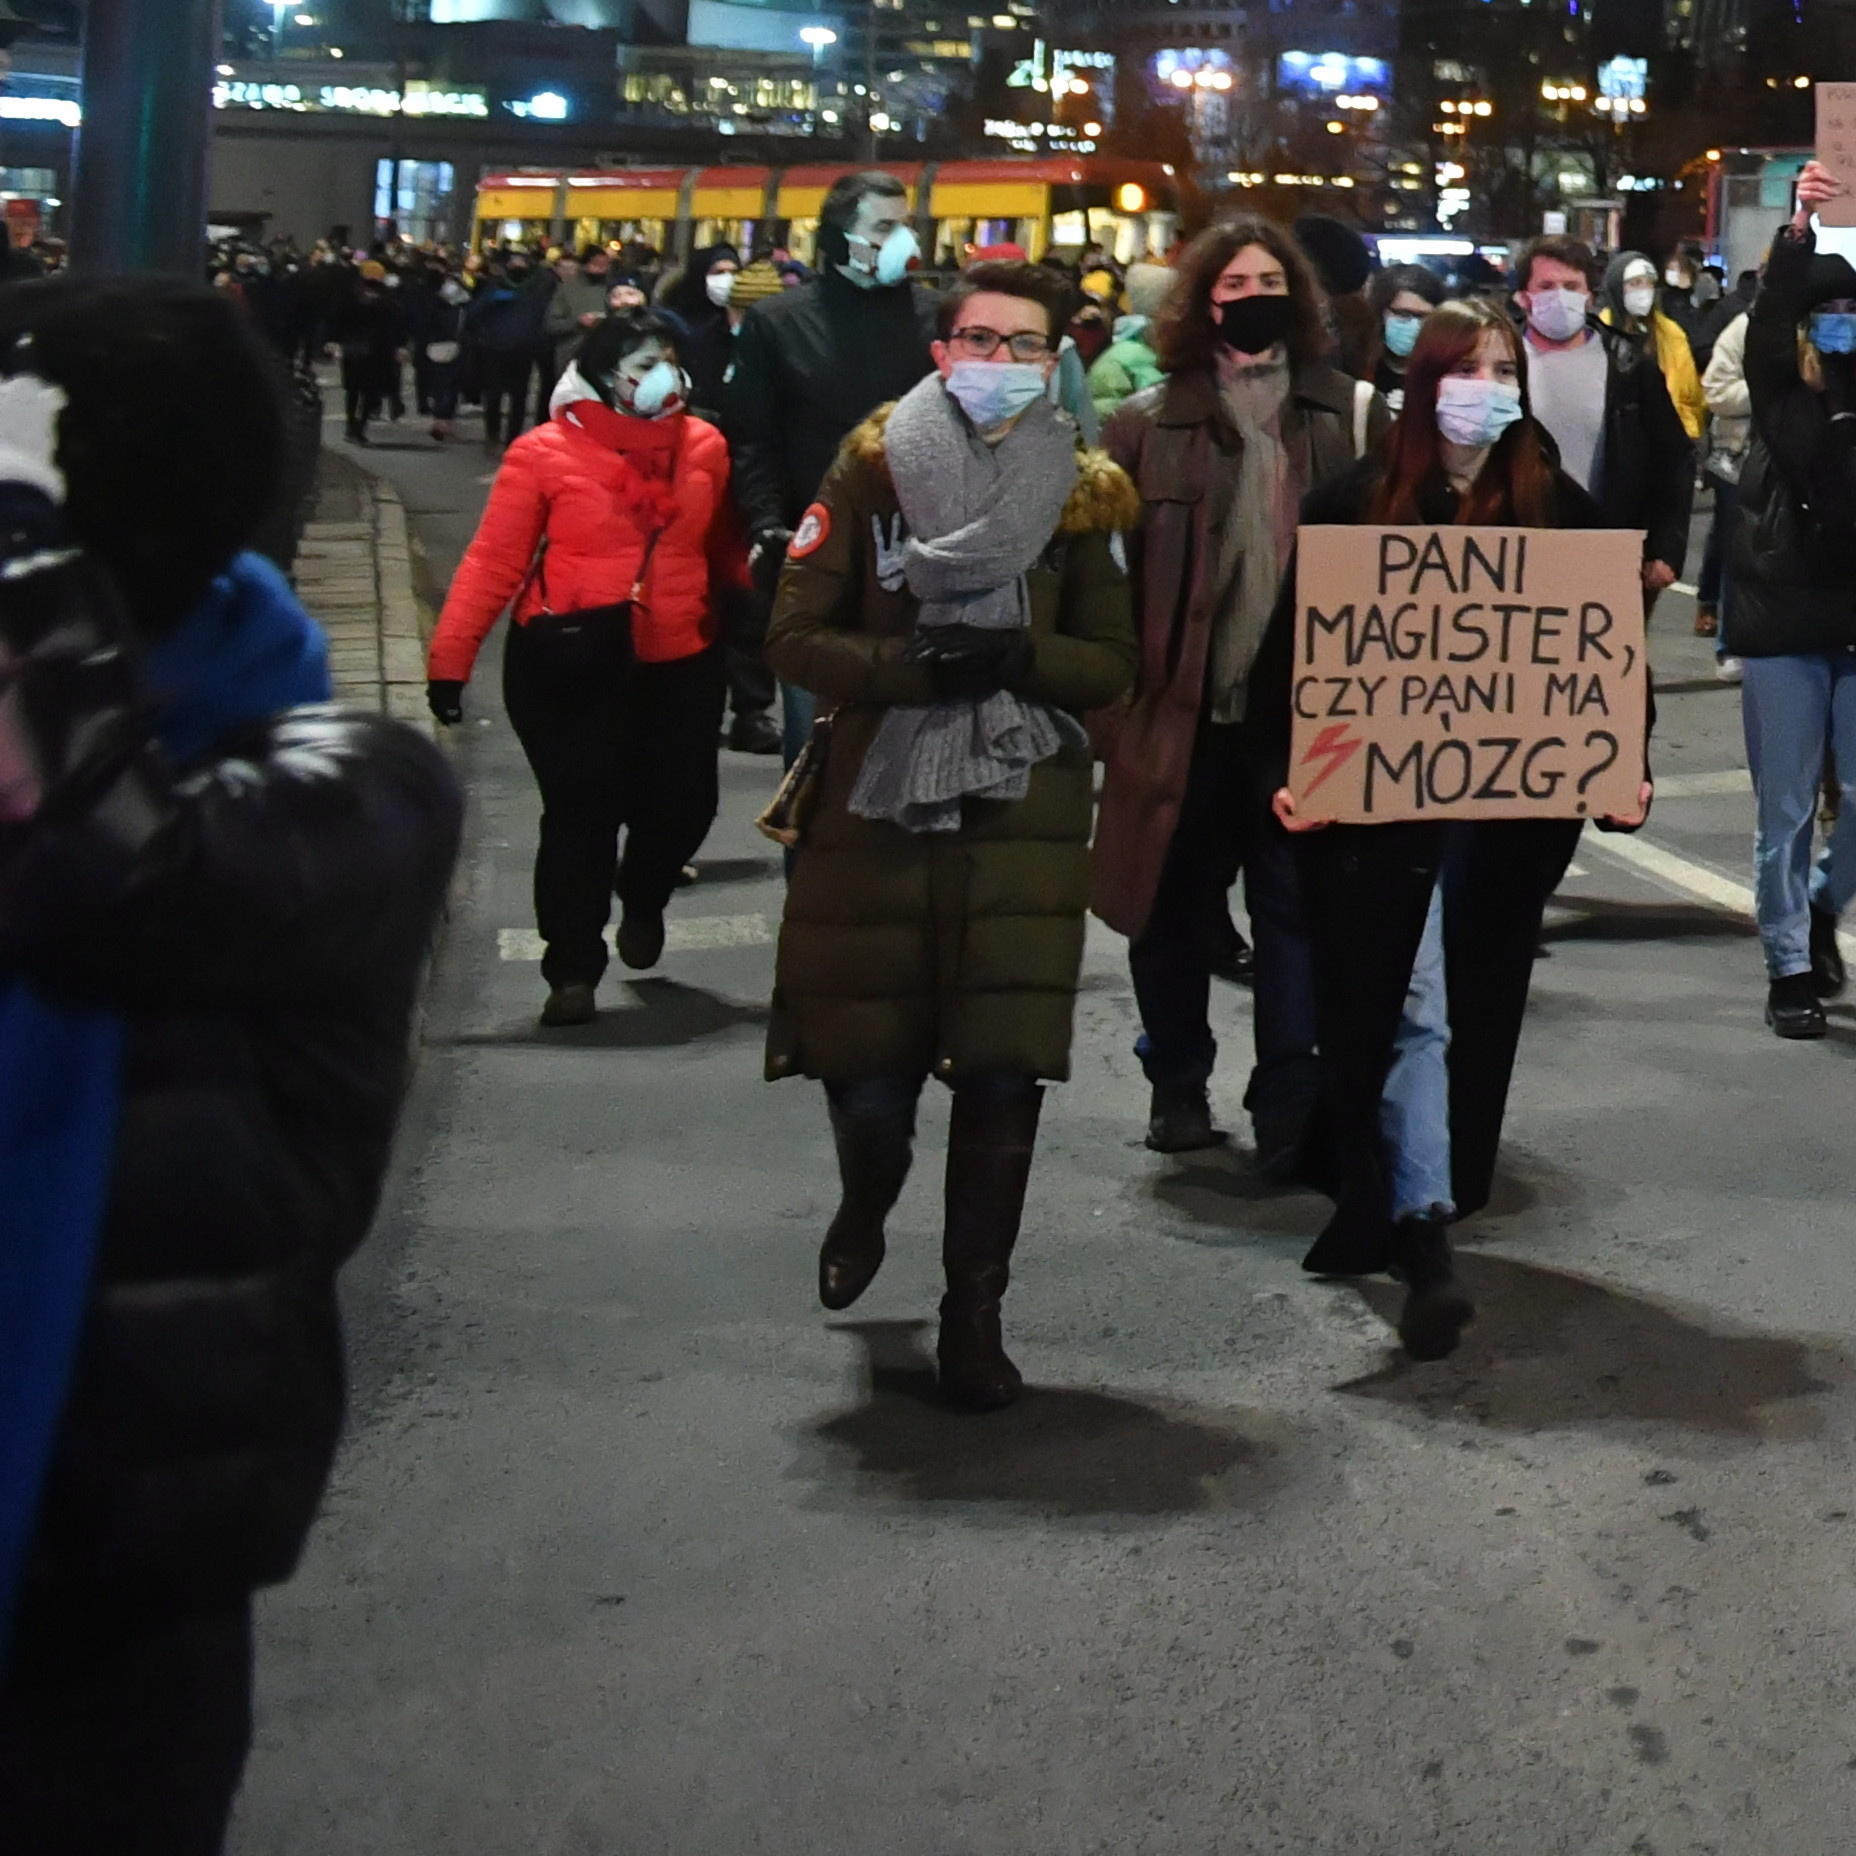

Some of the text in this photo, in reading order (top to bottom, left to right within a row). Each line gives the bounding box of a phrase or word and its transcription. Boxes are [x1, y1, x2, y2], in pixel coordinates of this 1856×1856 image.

[1377, 531, 1527, 595] PANI
[1304, 601, 1636, 679] MAGISTER,
[1294, 672, 1609, 720] CZY PANI MA
[1363, 710, 1620, 814] MÓZG?
